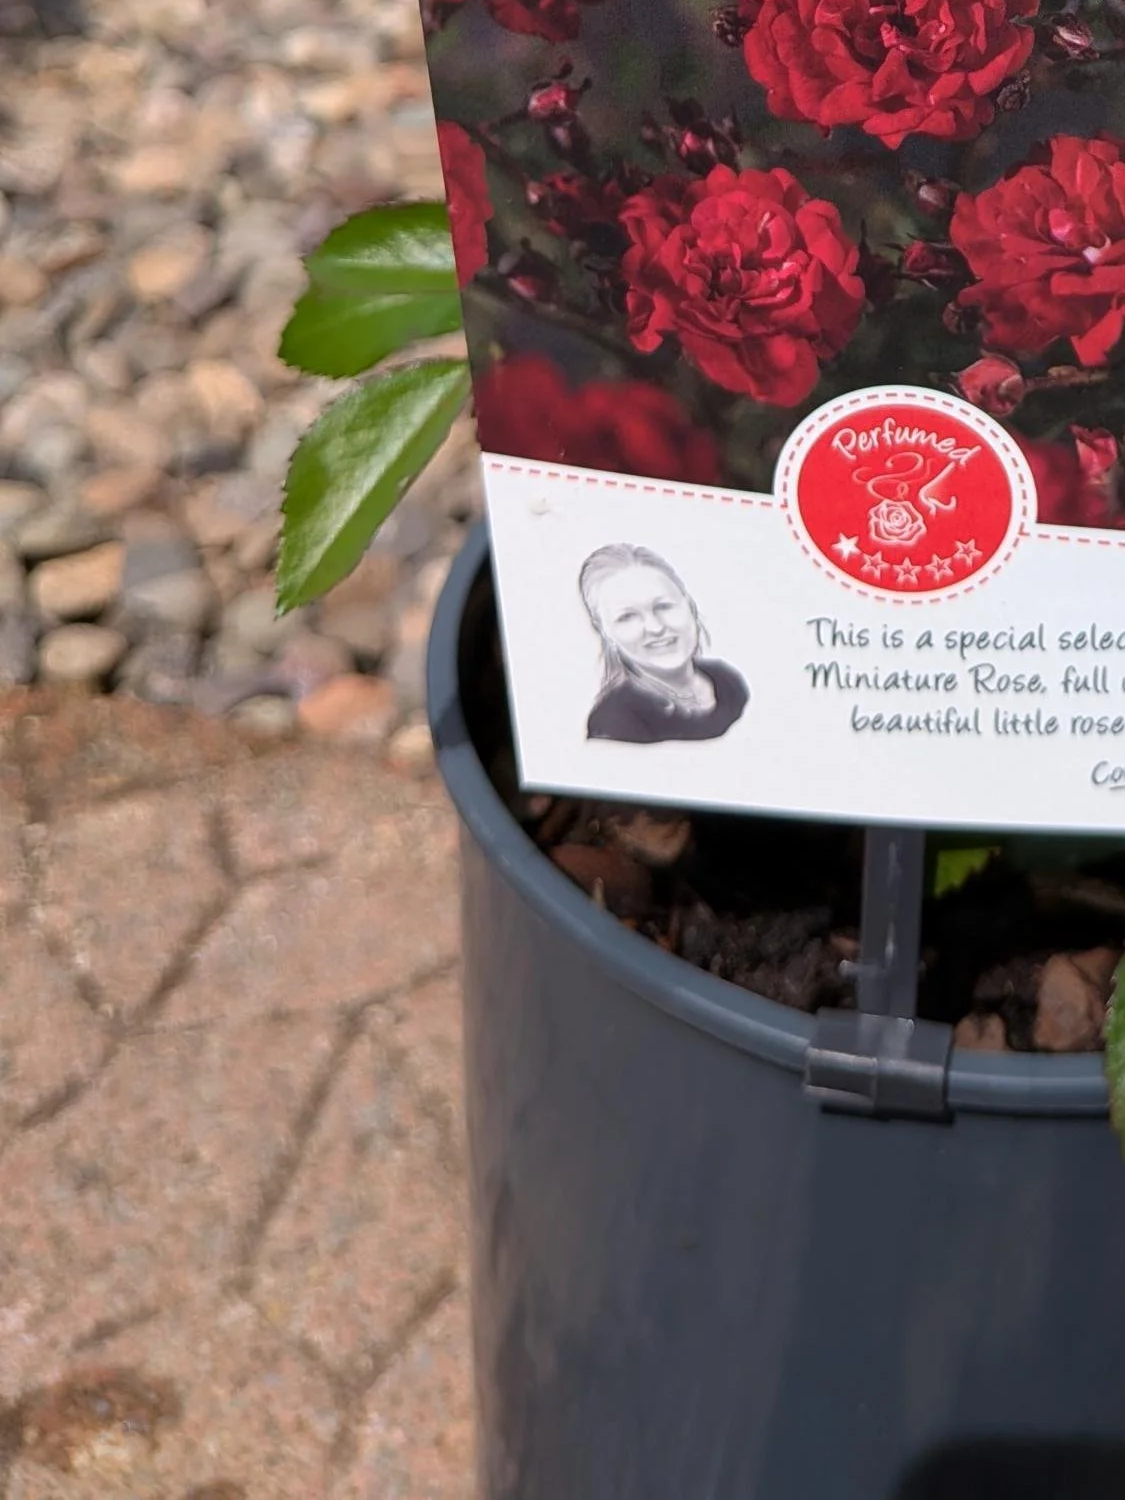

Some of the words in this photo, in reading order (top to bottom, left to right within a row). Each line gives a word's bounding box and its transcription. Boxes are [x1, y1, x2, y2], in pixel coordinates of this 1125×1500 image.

[832, 417, 982, 466] Perfumed
[806, 617, 870, 648] This
[882, 623, 904, 648] is
[916, 628, 934, 650] a
[944, 624, 1046, 660] special
[804, 662, 958, 692] Miniature
[1061, 665, 1109, 694] full
[851, 705, 980, 735] beautiful
[993, 707, 1060, 735] little
